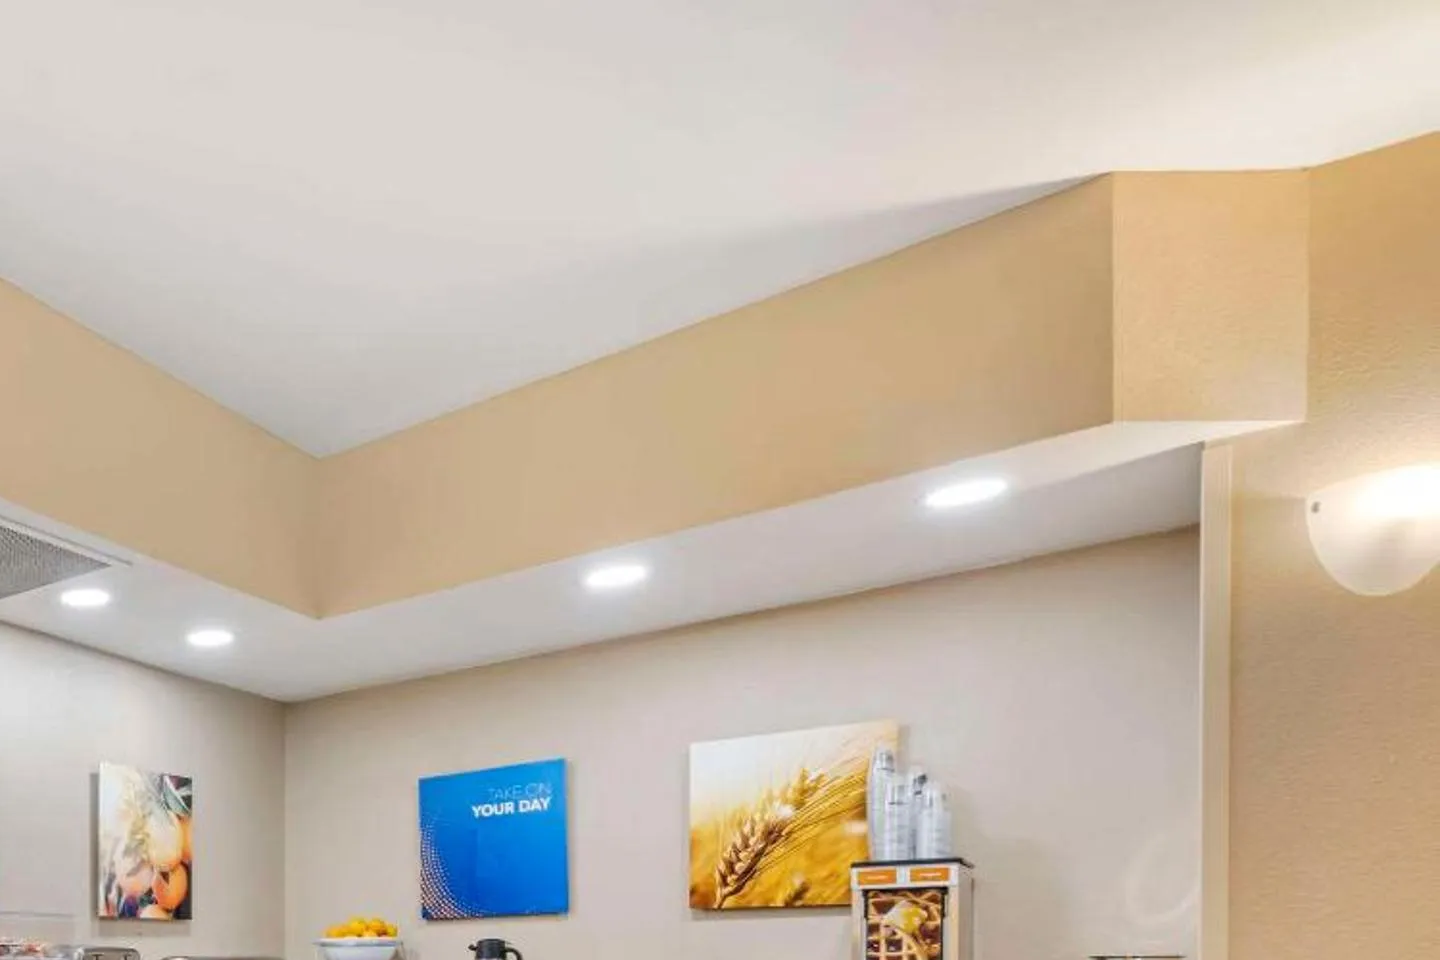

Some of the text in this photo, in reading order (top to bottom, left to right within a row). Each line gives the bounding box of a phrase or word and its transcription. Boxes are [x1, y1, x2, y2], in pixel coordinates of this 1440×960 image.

[488, 782, 553, 800] TAKE ON
[471, 796, 552, 819] YOUR DAY
